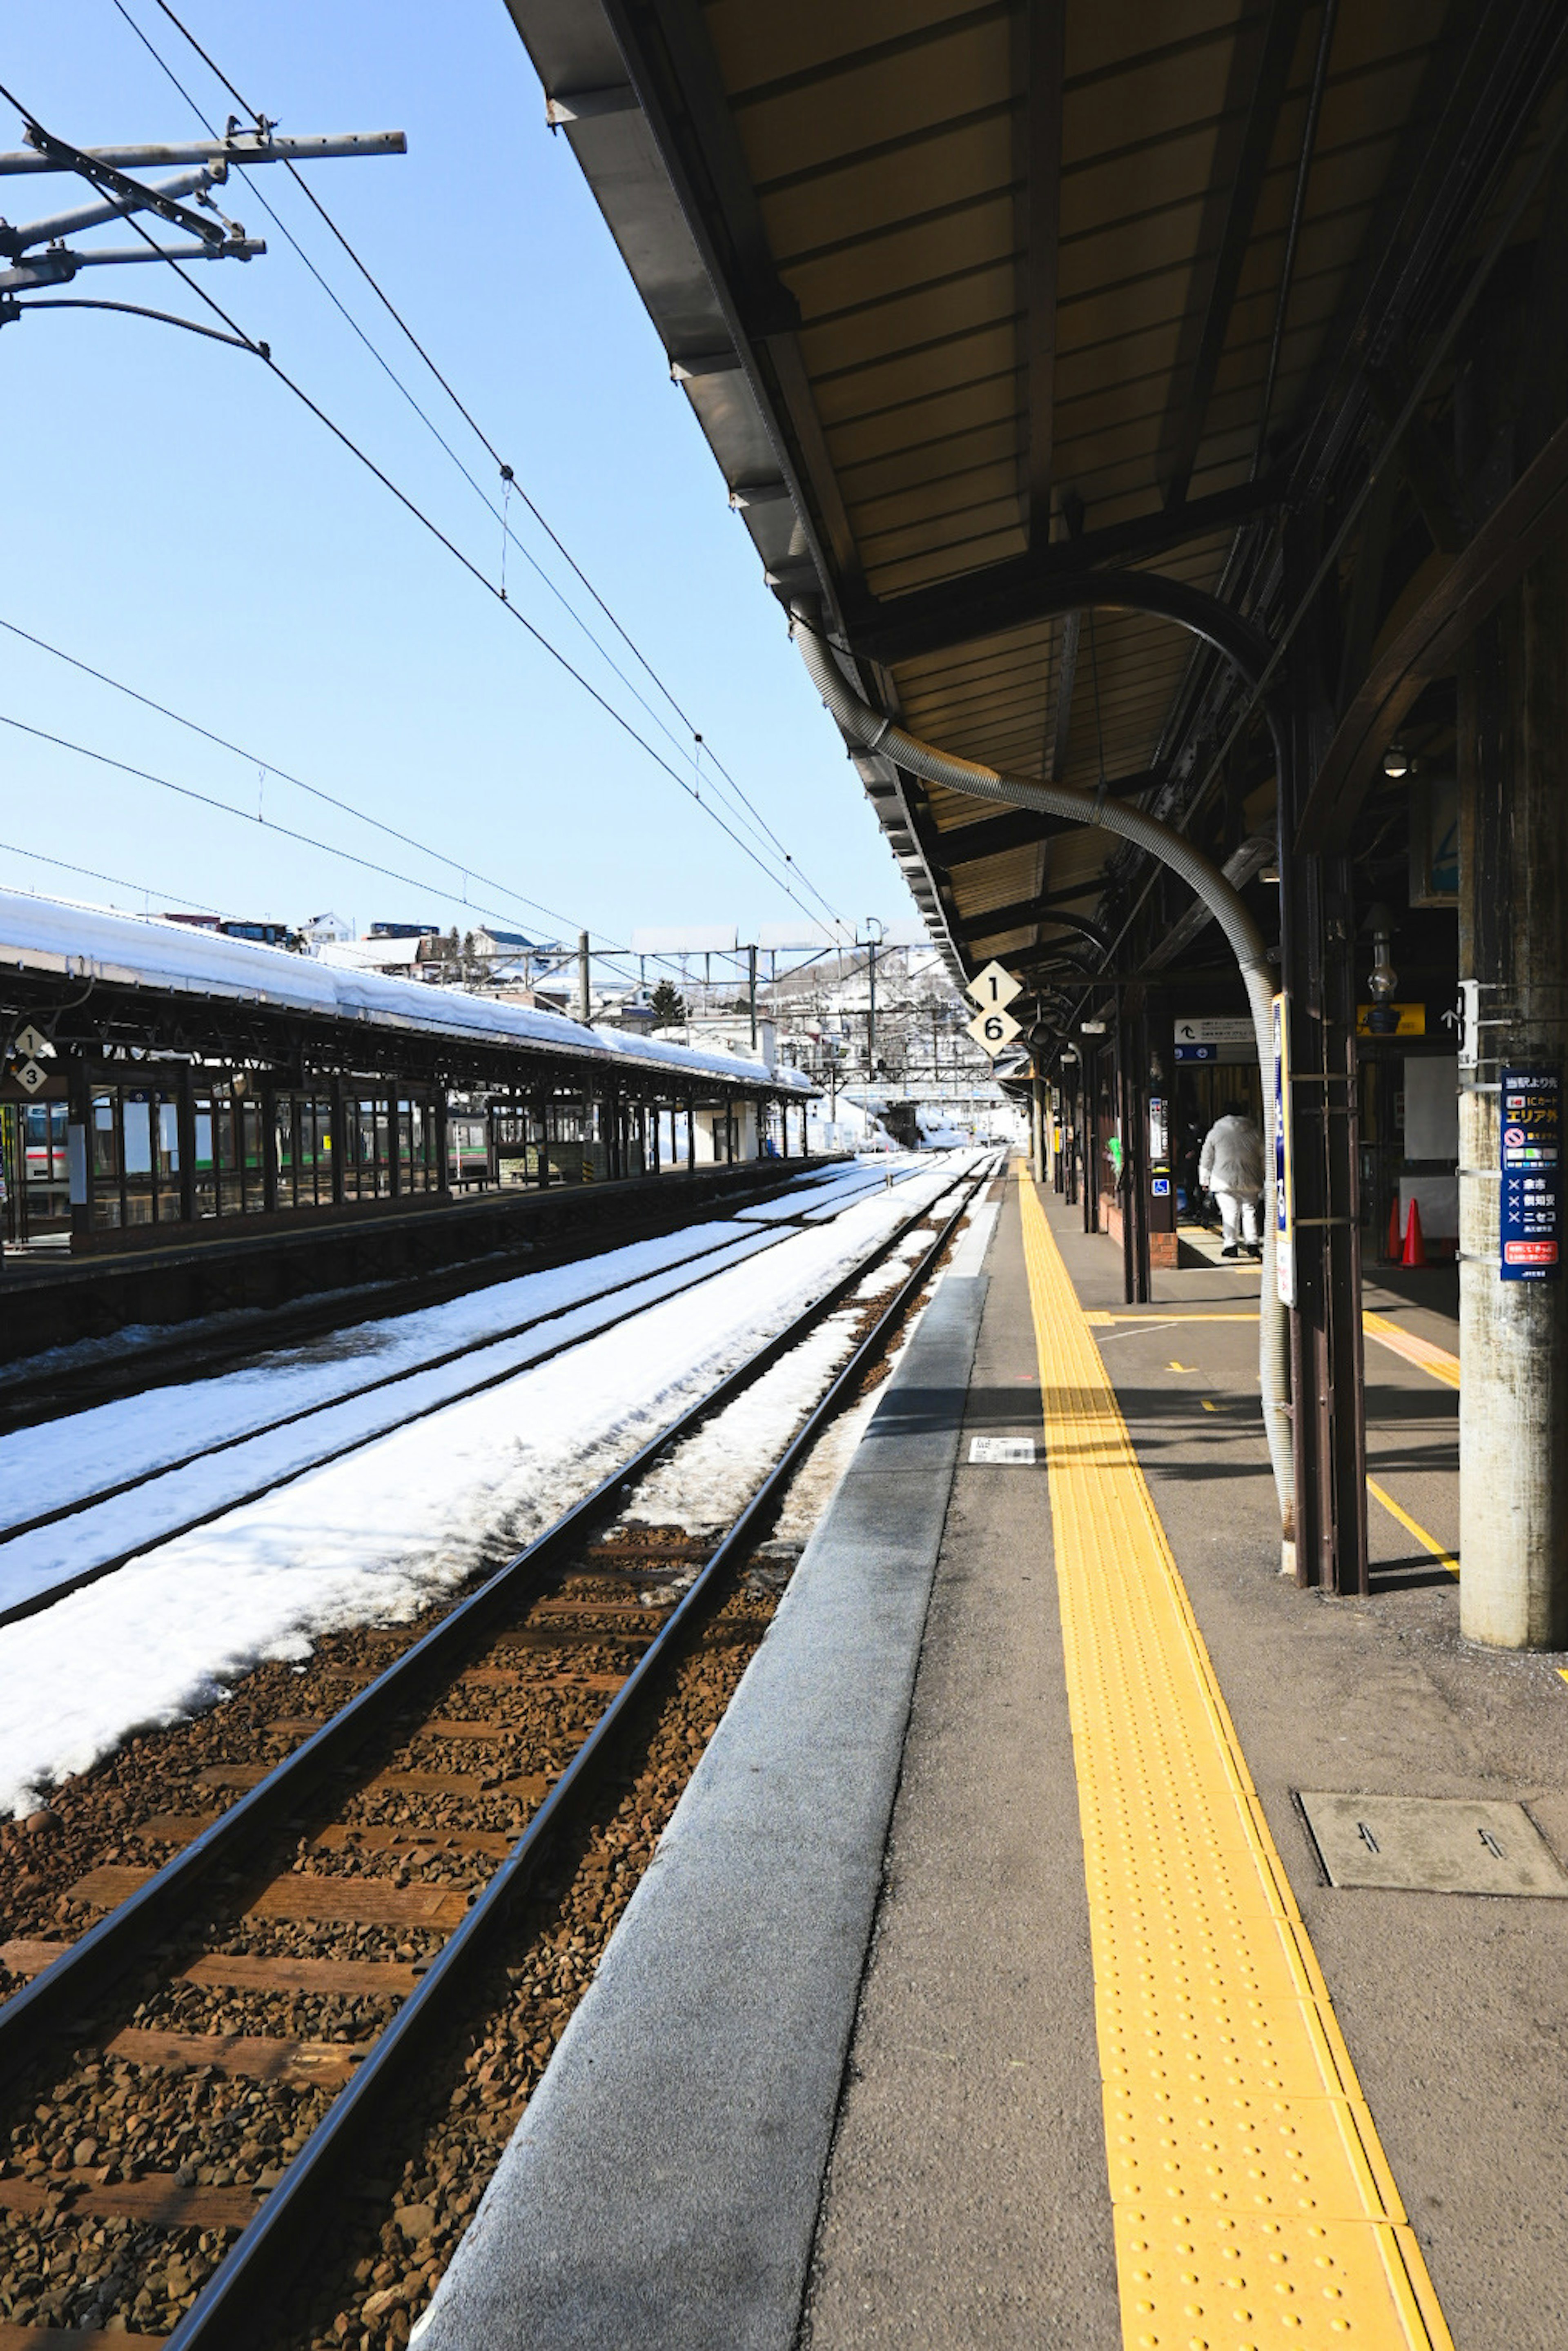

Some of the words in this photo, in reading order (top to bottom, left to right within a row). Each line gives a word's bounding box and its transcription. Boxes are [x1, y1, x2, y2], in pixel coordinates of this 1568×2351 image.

[988, 977, 998, 1001] 1
[985, 1017, 1004, 1040] 6
[27, 1034, 33, 1050] 1
[26, 1069, 37, 1085] 3
[1506, 1077, 1558, 1089] 当駅より先
[1506, 1109, 1558, 1124] エリア外
[1523, 1211, 1556, 1223] ニセコ
